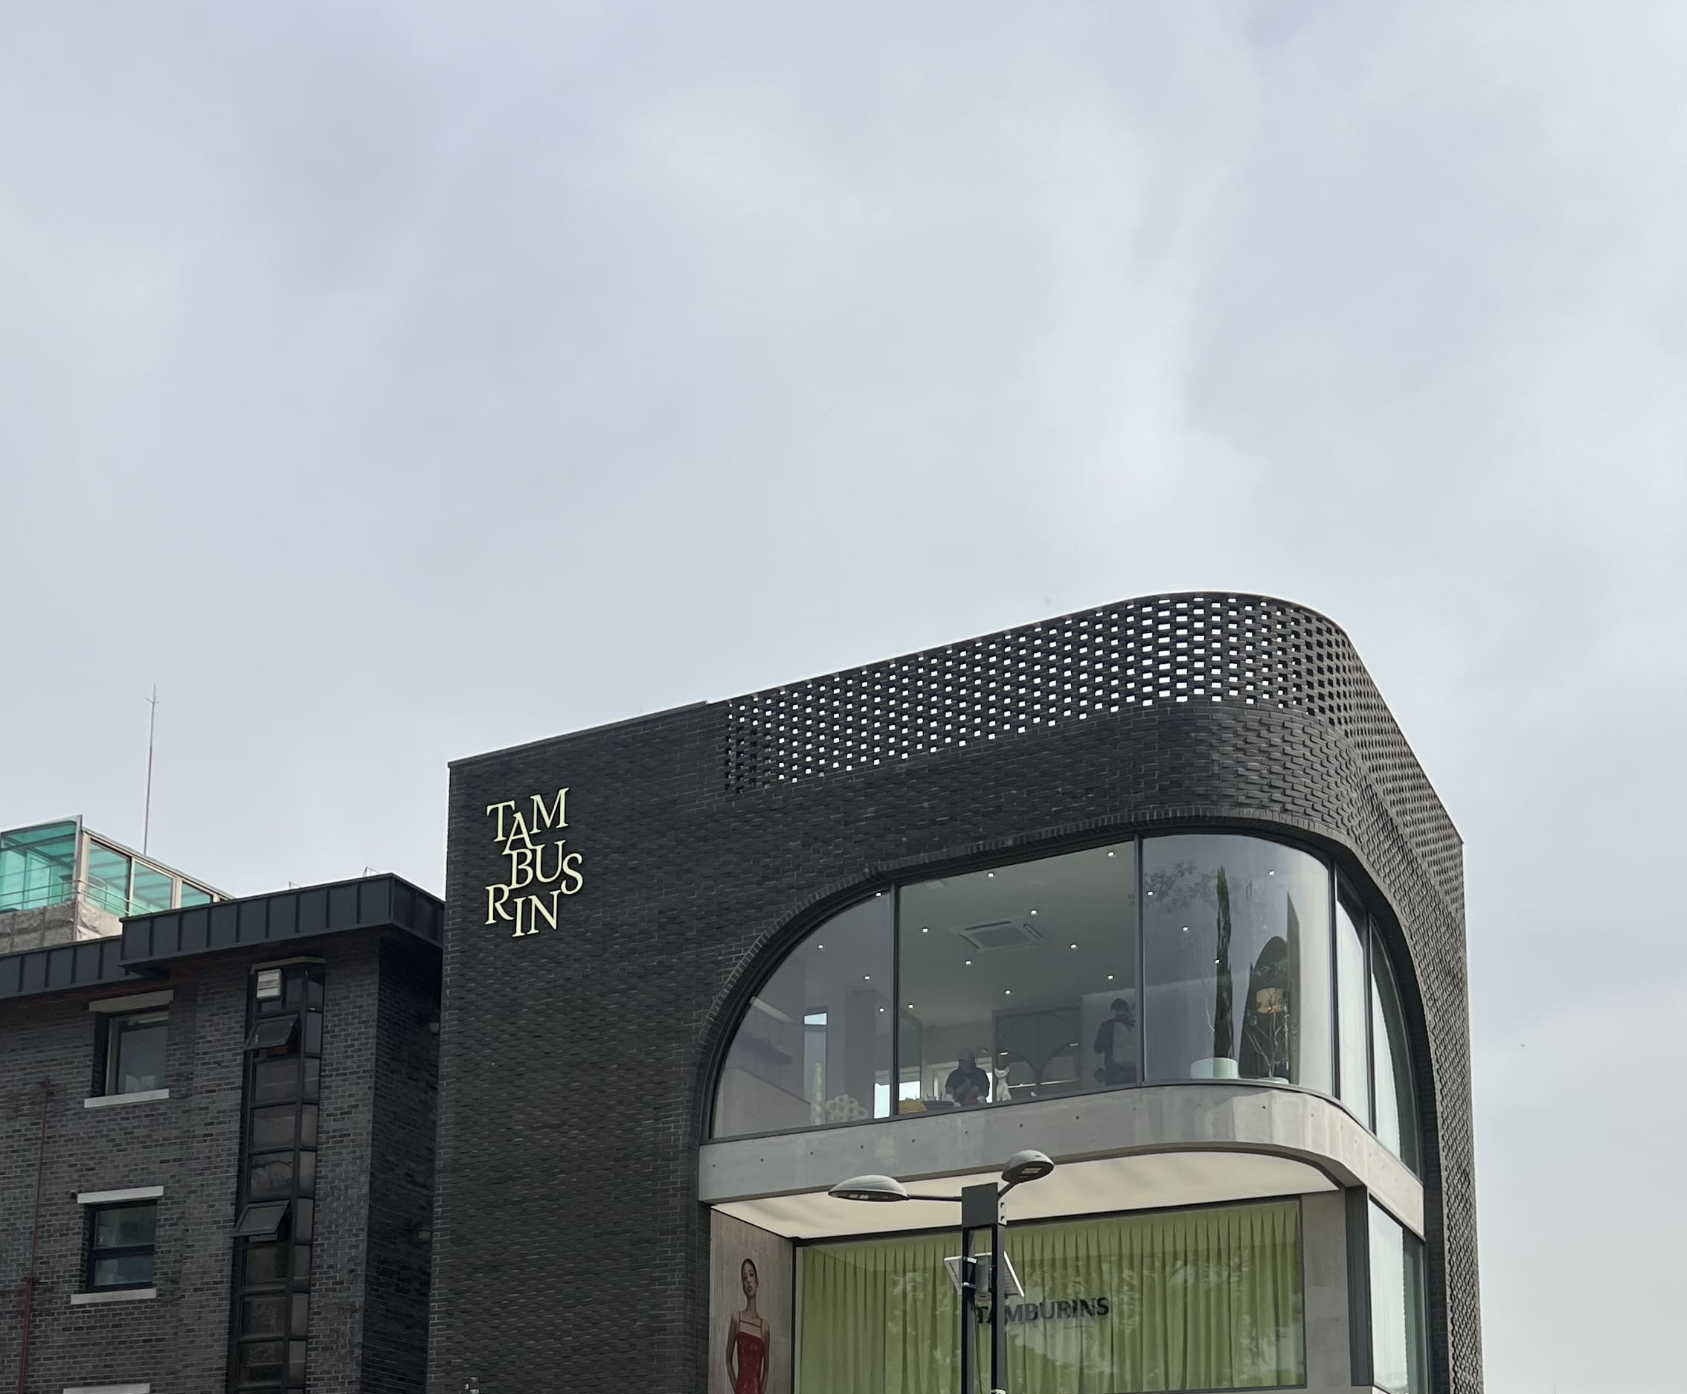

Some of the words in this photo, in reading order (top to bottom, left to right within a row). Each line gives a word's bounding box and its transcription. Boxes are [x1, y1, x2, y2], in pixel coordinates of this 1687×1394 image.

[486, 787, 570, 855] TAM
[484, 883, 562, 938] RIN
[976, 1297, 1110, 1324] TMBURINS
